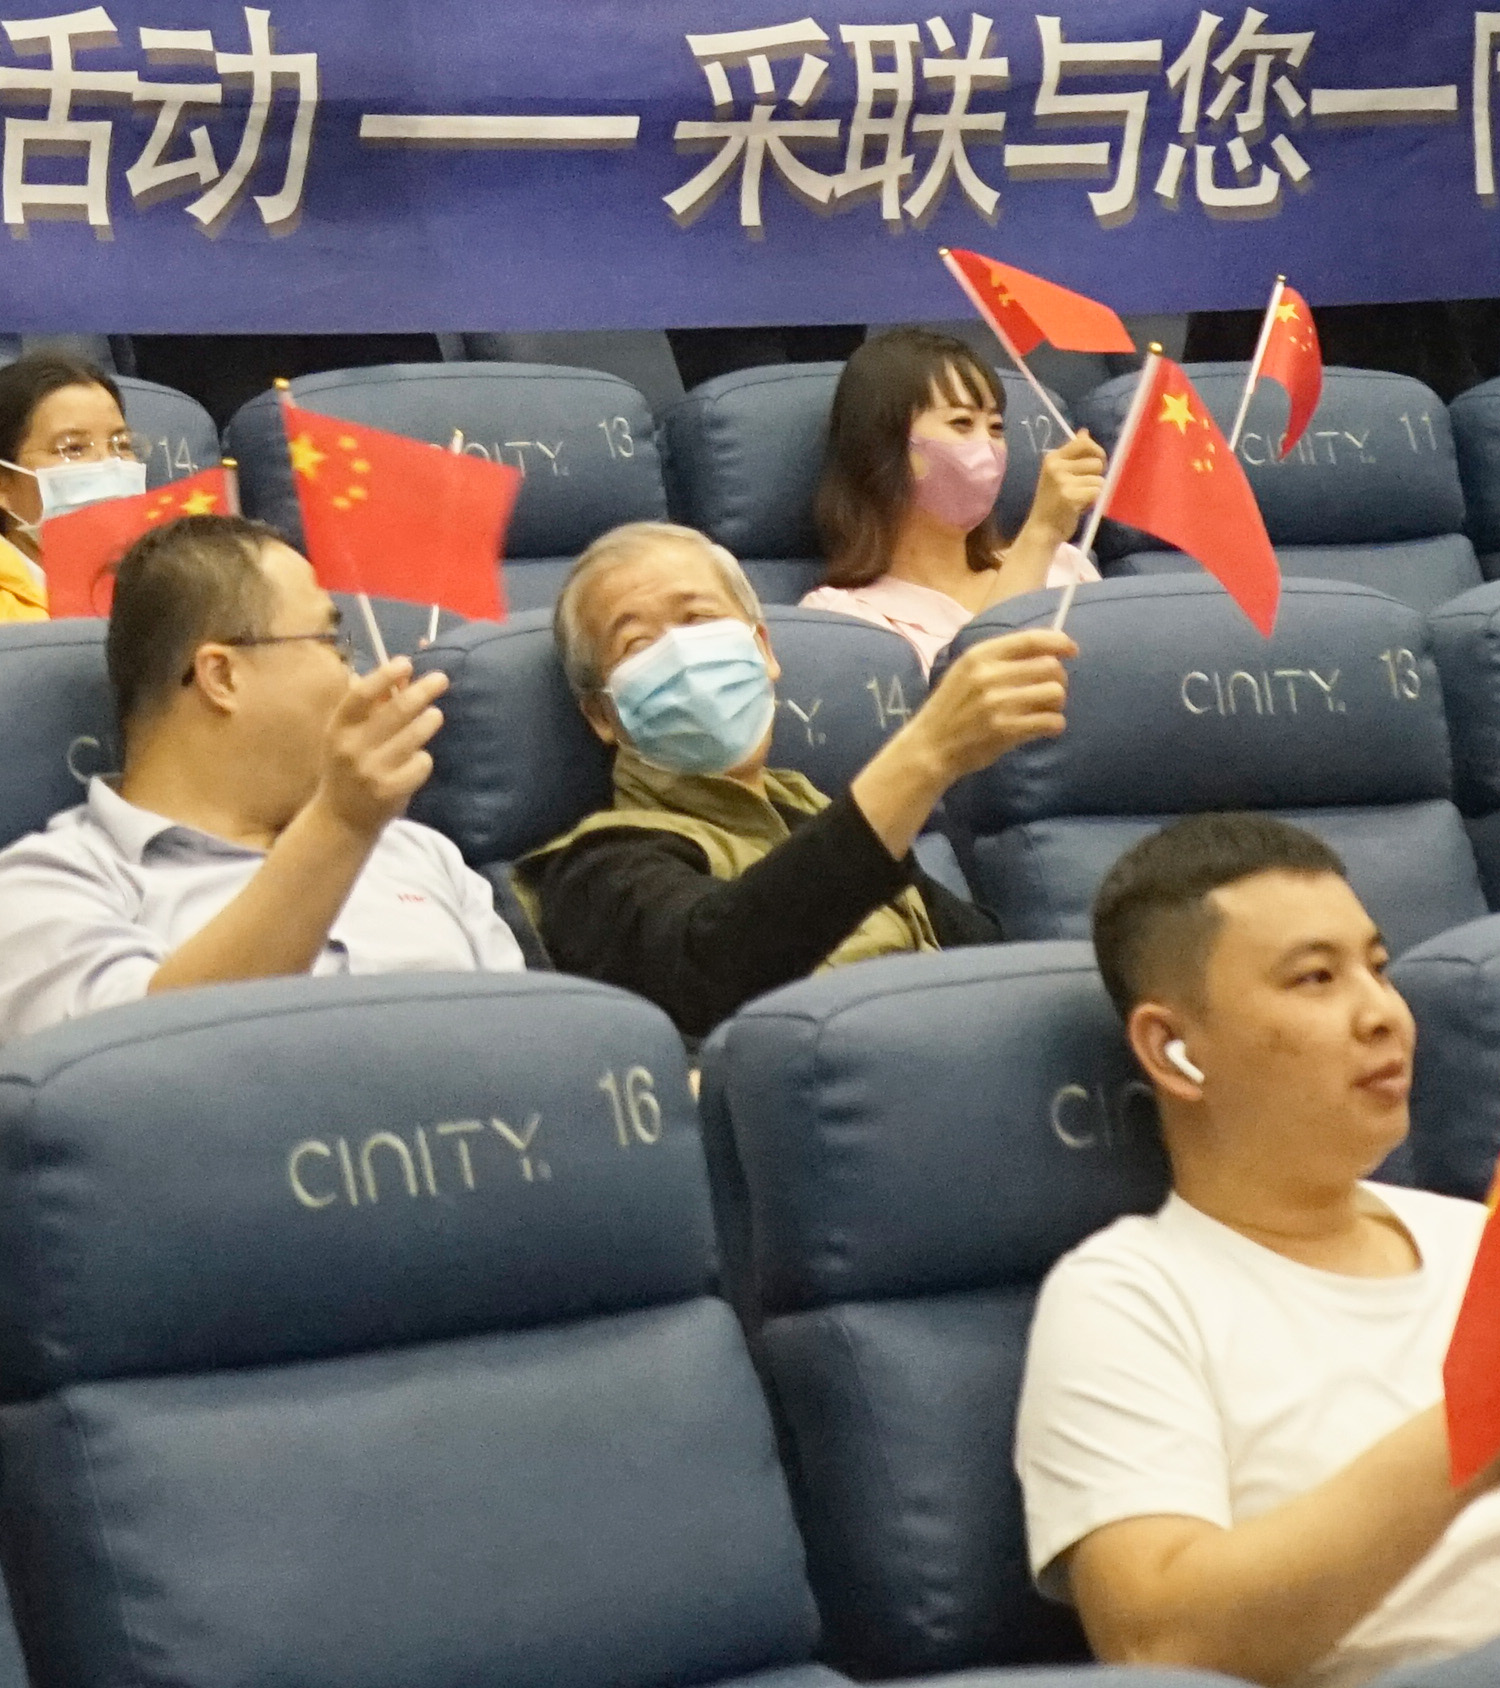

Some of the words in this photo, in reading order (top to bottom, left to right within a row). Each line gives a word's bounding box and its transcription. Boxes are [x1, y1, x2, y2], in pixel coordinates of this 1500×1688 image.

[158, 436, 199, 479] 14
[598, 417, 635, 460] 13
[866, 674, 913, 731] 14
[1180, 668, 1342, 716] CINITY
[1379, 647, 1421, 701] 13
[286, 1112, 545, 1210] CINITY
[599, 1065, 664, 1149] 16
